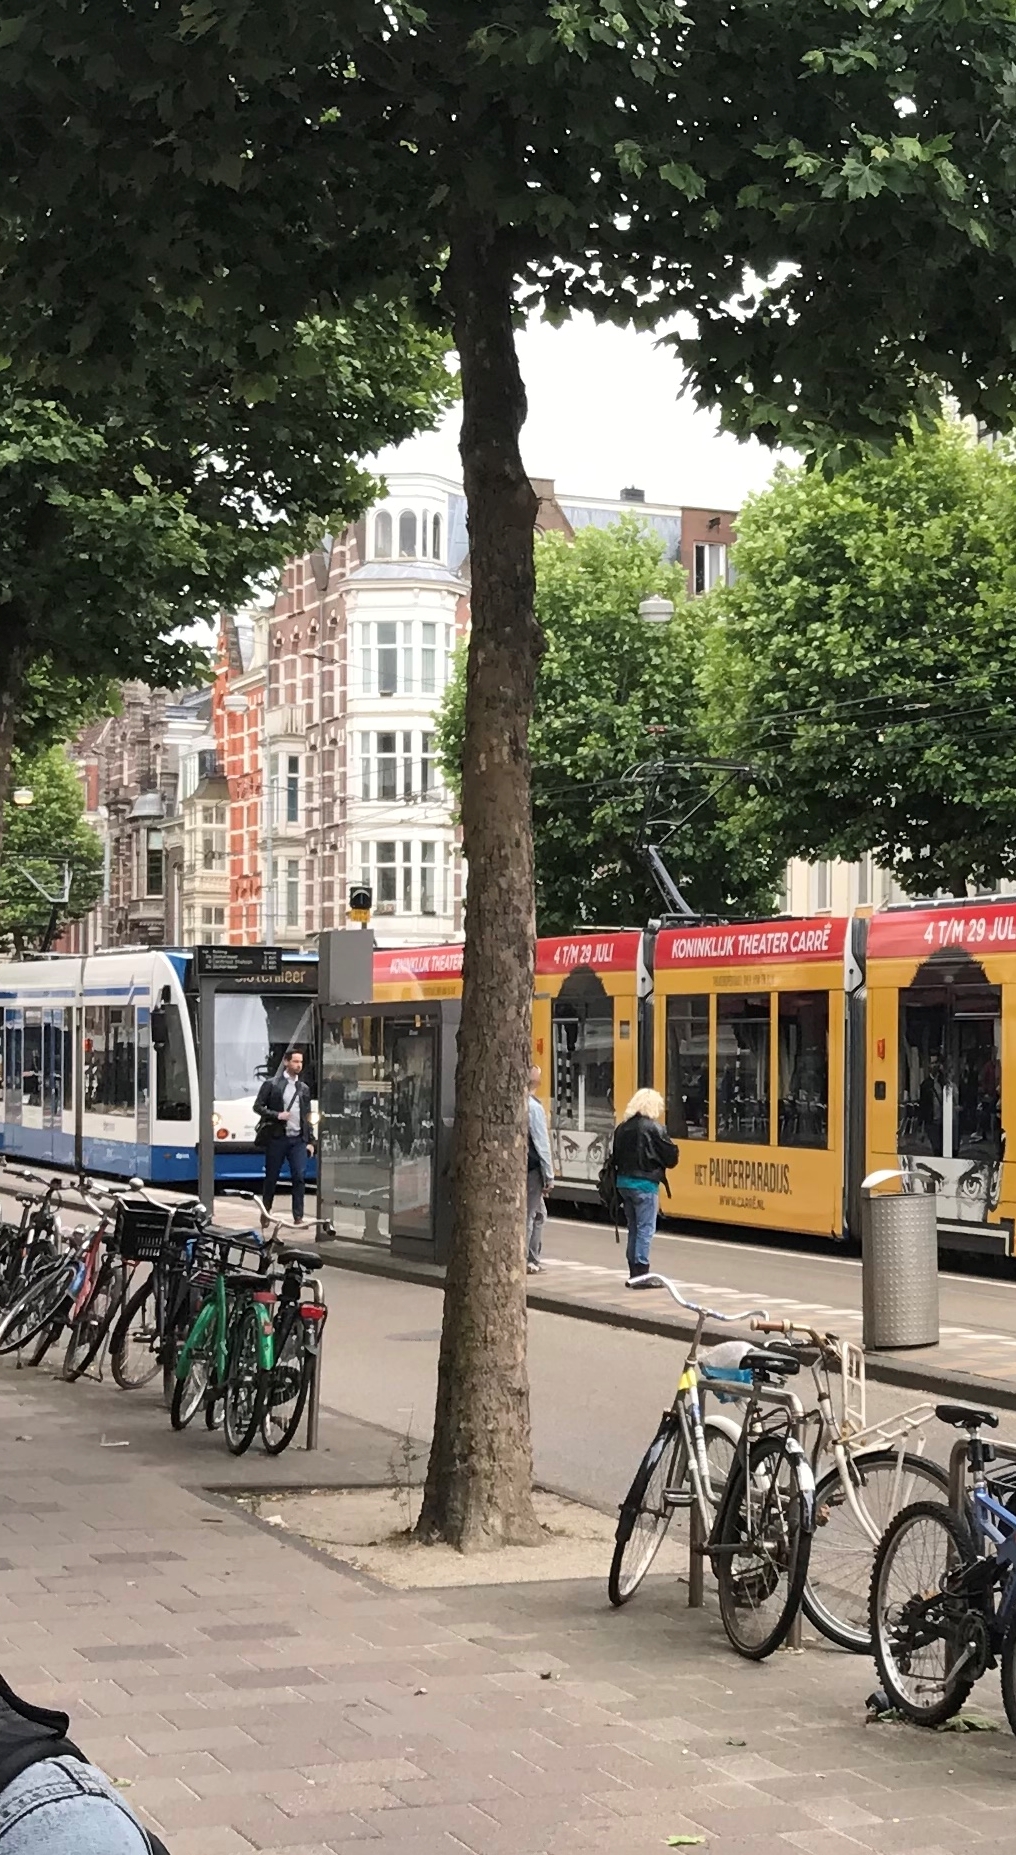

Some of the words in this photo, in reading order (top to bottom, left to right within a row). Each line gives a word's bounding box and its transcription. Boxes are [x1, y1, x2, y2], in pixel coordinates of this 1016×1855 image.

[671, 935, 736, 959] KONINKLIJK
[738, 931, 789, 955] THEATER
[924, 921, 935, 944] 4
[938, 916, 965, 947] T/M
[966, 917, 986, 942] 29
[553, 946, 561, 965] 4
[562, 943, 580, 967] T/M
[580, 943, 592, 963] 29
[592, 942, 615, 962] JULI
[694, 1163, 708, 1187] HET
[709, 1157, 793, 1196] PAUPERPARADIJS.
